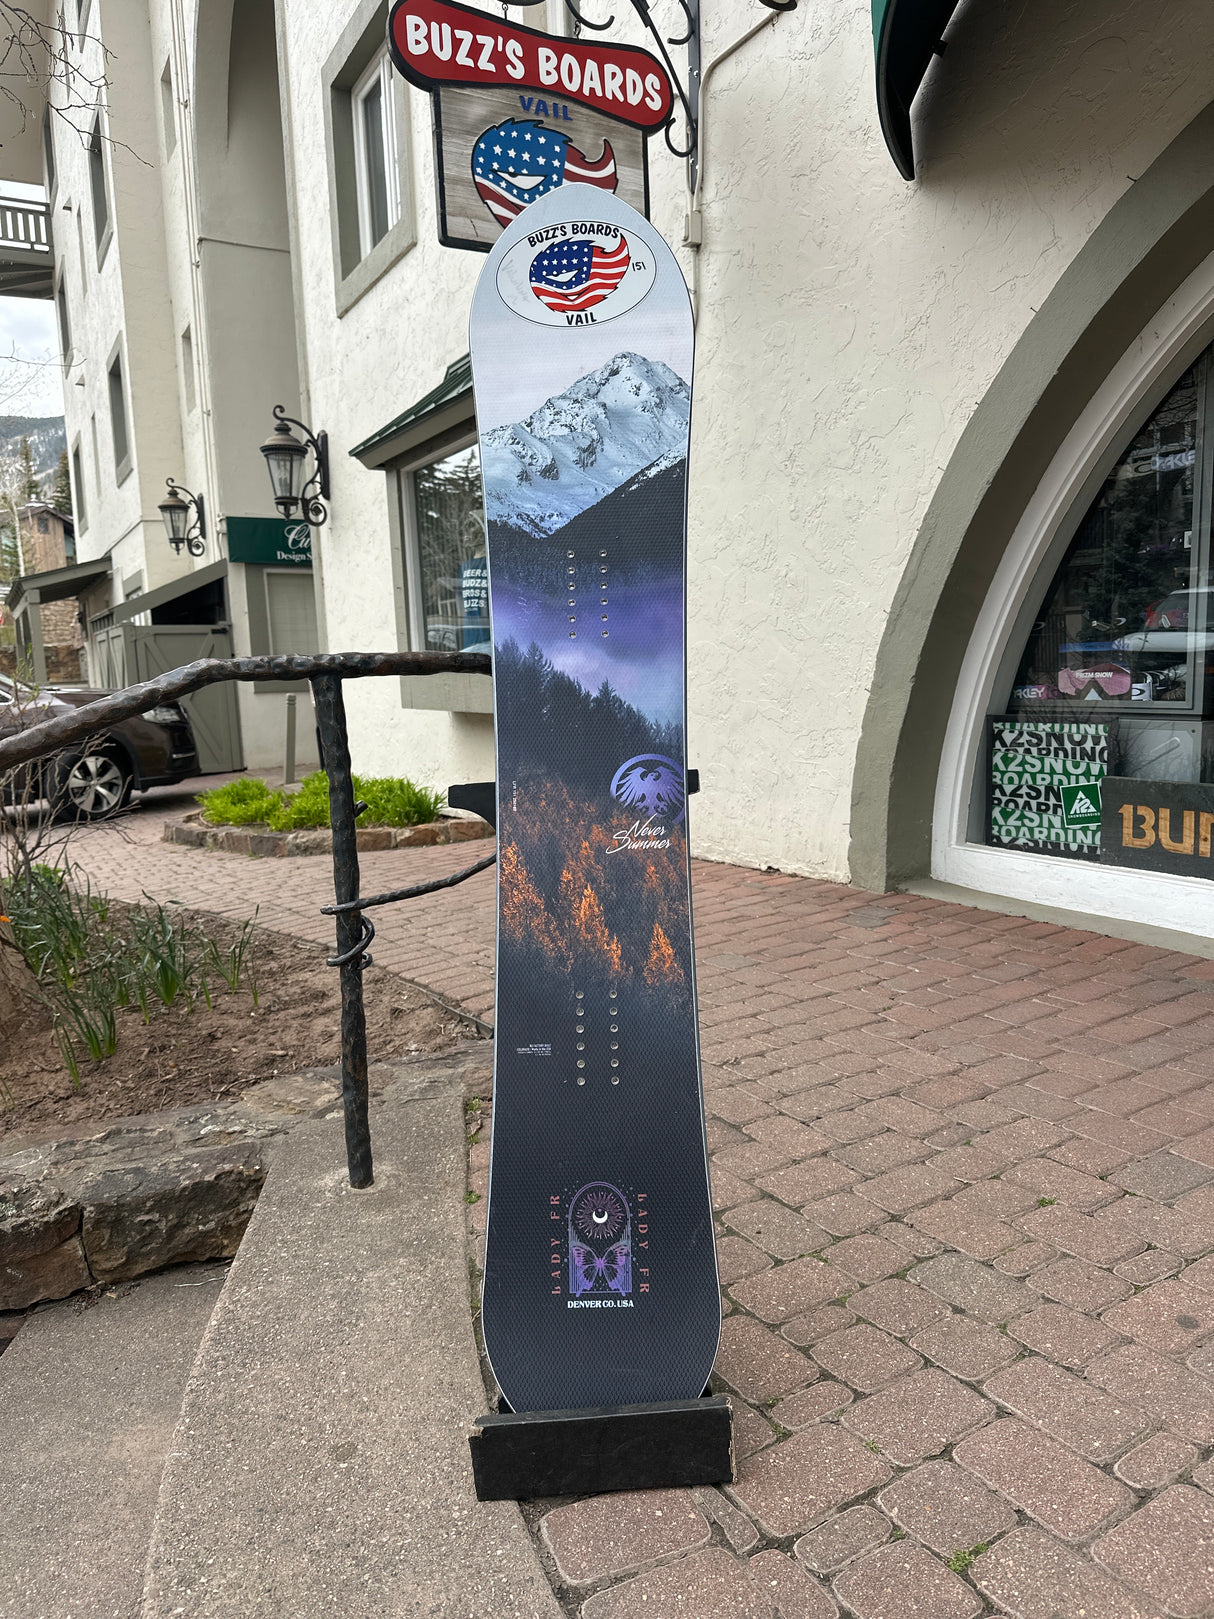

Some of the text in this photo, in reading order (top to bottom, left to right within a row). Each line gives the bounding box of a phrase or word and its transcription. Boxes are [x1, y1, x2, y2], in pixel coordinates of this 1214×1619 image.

[405, 14, 663, 112] BUZZ'S BOARDS
[519, 95, 573, 121] VAIL
[527, 223, 620, 248] BUZZ'S BOARDS
[566, 312, 597, 326] VAIL
[276, 551, 306, 563] Design
[1094, 671, 1114, 679] SNOW
[627, 812, 666, 838] Never
[605, 830, 673, 855] Summer
[550, 1195, 562, 1295] LADY FR
[637, 1193, 650, 1293] LADY FR
[567, 1300, 602, 1309] DENVER
[617, 1299, 634, 1308] USA
